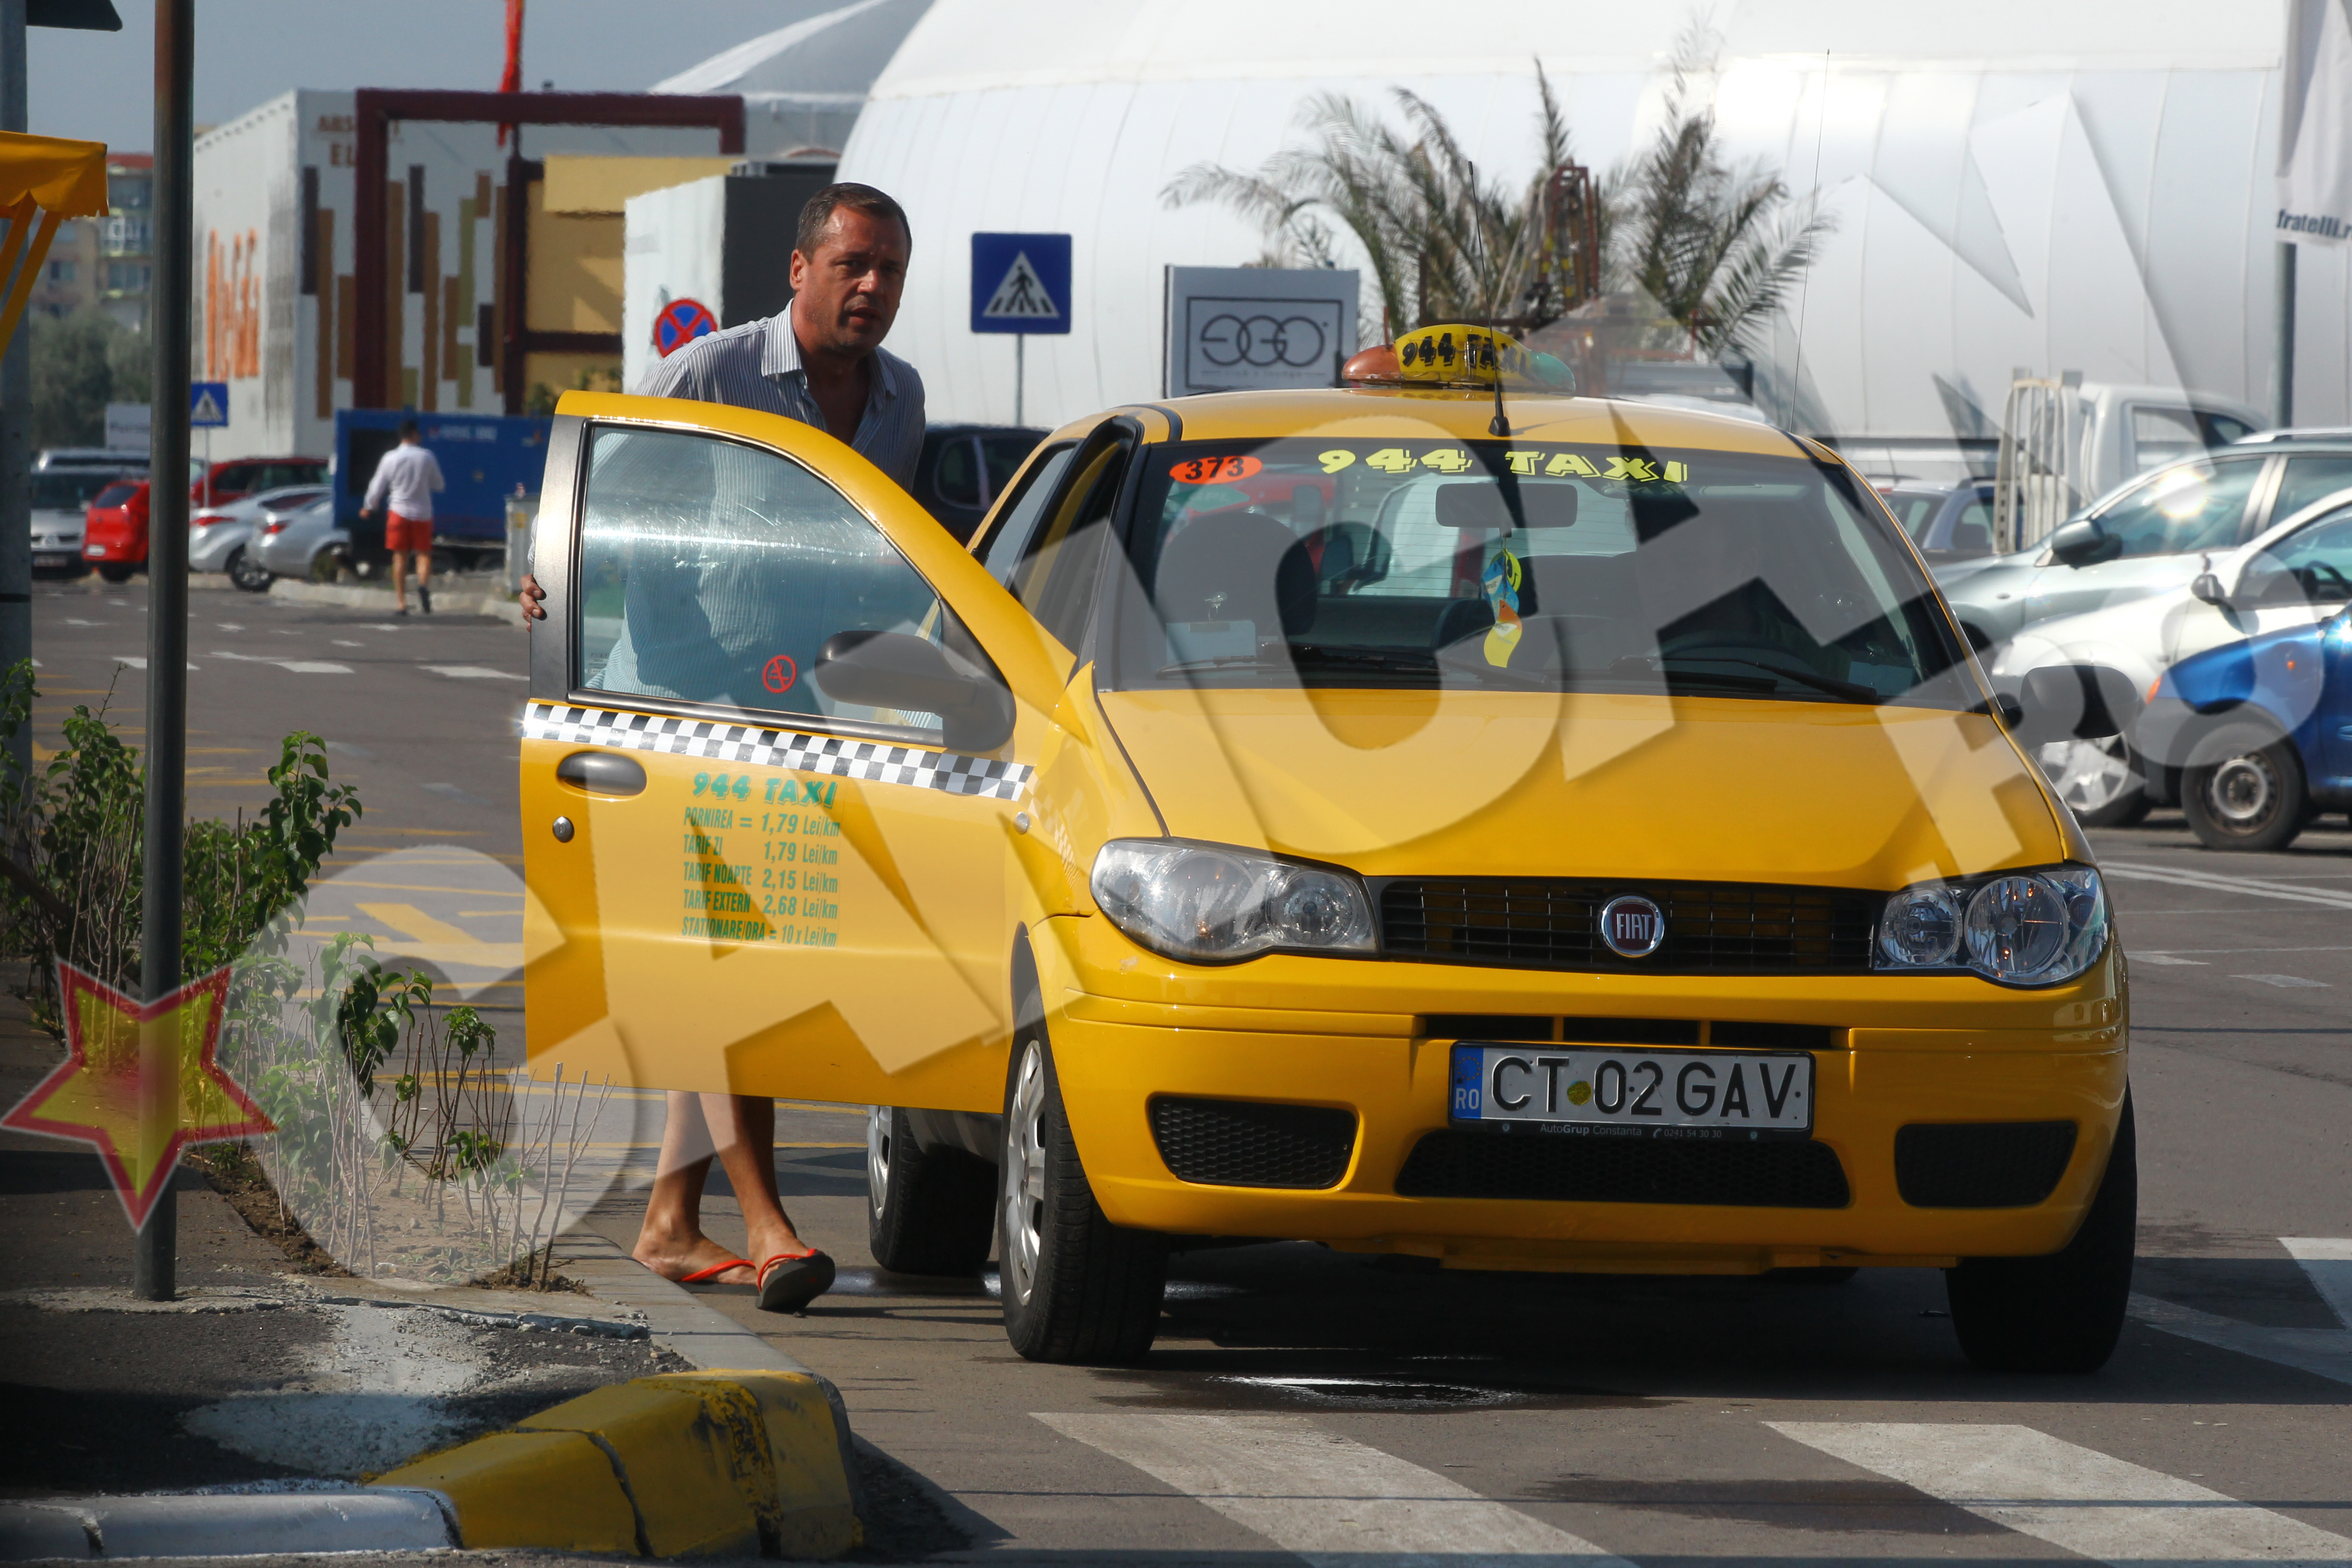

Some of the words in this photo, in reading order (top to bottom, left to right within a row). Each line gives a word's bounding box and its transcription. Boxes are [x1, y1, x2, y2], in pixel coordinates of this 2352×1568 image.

[2277, 208, 2352, 239] fratelli.r
[1200, 313, 1325, 367] EGO
[1402, 332, 1456, 367] 944
[1465, 333, 1528, 377] TAXI
[1185, 457, 1244, 480] 373
[1318, 447, 1473, 475] 944
[1504, 451, 1688, 483] TAXI
[692, 772, 752, 802] 944
[764, 778, 838, 809] TAXI
[684, 807, 733, 829] PORNIREA
[739, 817, 752, 828] =
[762, 813, 798, 835] 1,79
[803, 815, 840, 837] Lei/km
[684, 834, 711, 855] TARIF
[713, 836, 723, 856] ZI
[764, 841, 796, 863] 1,79
[803, 843, 838, 865] Lei/km
[684, 862, 711, 882] TARIF
[714, 864, 752, 885] NOAPTE
[762, 869, 796, 892] 2,15
[803, 871, 838, 894] Lei/km
[684, 889, 711, 910] TARIF
[713, 891, 751, 913] EXTERN
[763, 894, 797, 918] 2,68
[802, 897, 838, 920] Lei/km
[682, 917, 765, 942] STATIONARE/ORA
[782, 925, 794, 943] 10
[795, 930, 802, 944] x
[803, 925, 837, 948] Lei/km
[1616, 913, 1652, 940] FIAT
[1455, 1087, 1480, 1111] RO
[1492, 1056, 1569, 1113] CT
[1593, 1059, 1664, 1116] 02
[1676, 1061, 1797, 1118] GAV
[1540, 1124, 1590, 1135] AutoGrup
[1593, 1125, 1642, 1136] Constanta
[1664, 1128, 1683, 1137] 0241
[1712, 1130, 1722, 1138] 30
